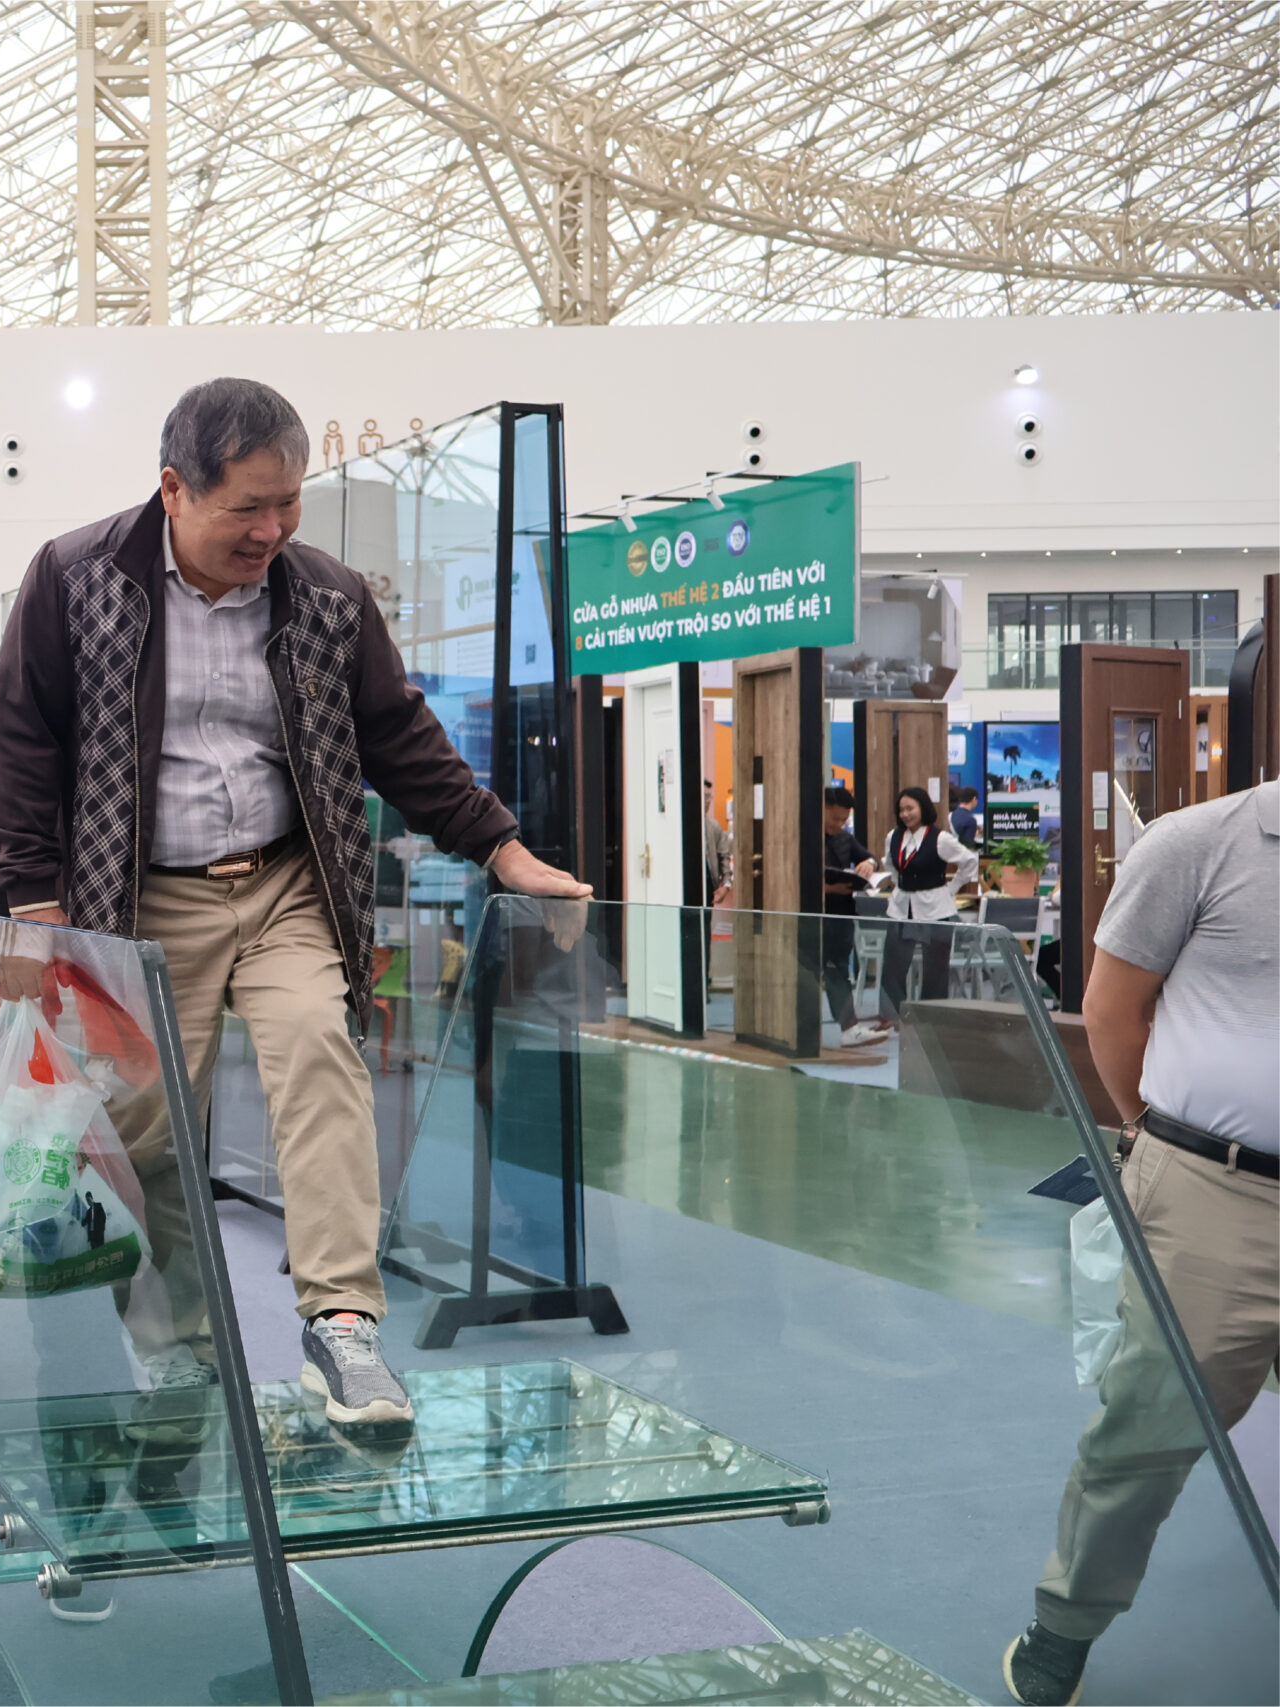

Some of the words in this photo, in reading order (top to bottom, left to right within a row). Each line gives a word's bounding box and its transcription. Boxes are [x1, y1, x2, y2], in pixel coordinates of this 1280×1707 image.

[573, 601, 598, 623] CỬA
[601, 594, 619, 619] GỖ
[621, 592, 658, 617] NHỰA
[660, 582, 687, 608] THẾ
[689, 580, 708, 606] HỆ
[711, 583, 719, 600] 2
[722, 571, 755, 599] ĐẦU
[758, 566, 793, 592] TIÊN
[796, 560, 826, 586] VỚI
[575, 636, 583, 651] 8
[585, 627, 605, 650] CẢI
[607, 622, 636, 646] TIẾN
[638, 619, 675, 643] VƯỢT
[677, 612, 709, 639] TRỘI
[711, 612, 732, 632] SO
[734, 604, 761, 628] VỚI
[764, 594, 795, 623] THẾ
[798, 593, 820, 621] HỆ
[823, 596, 831, 614] 1
[993, 811, 1010, 821] NHÀ
[1010, 811, 1028, 821] MÁY
[993, 821, 1016, 831] NHỰA
[1016, 821, 1033, 832] VIỆT
